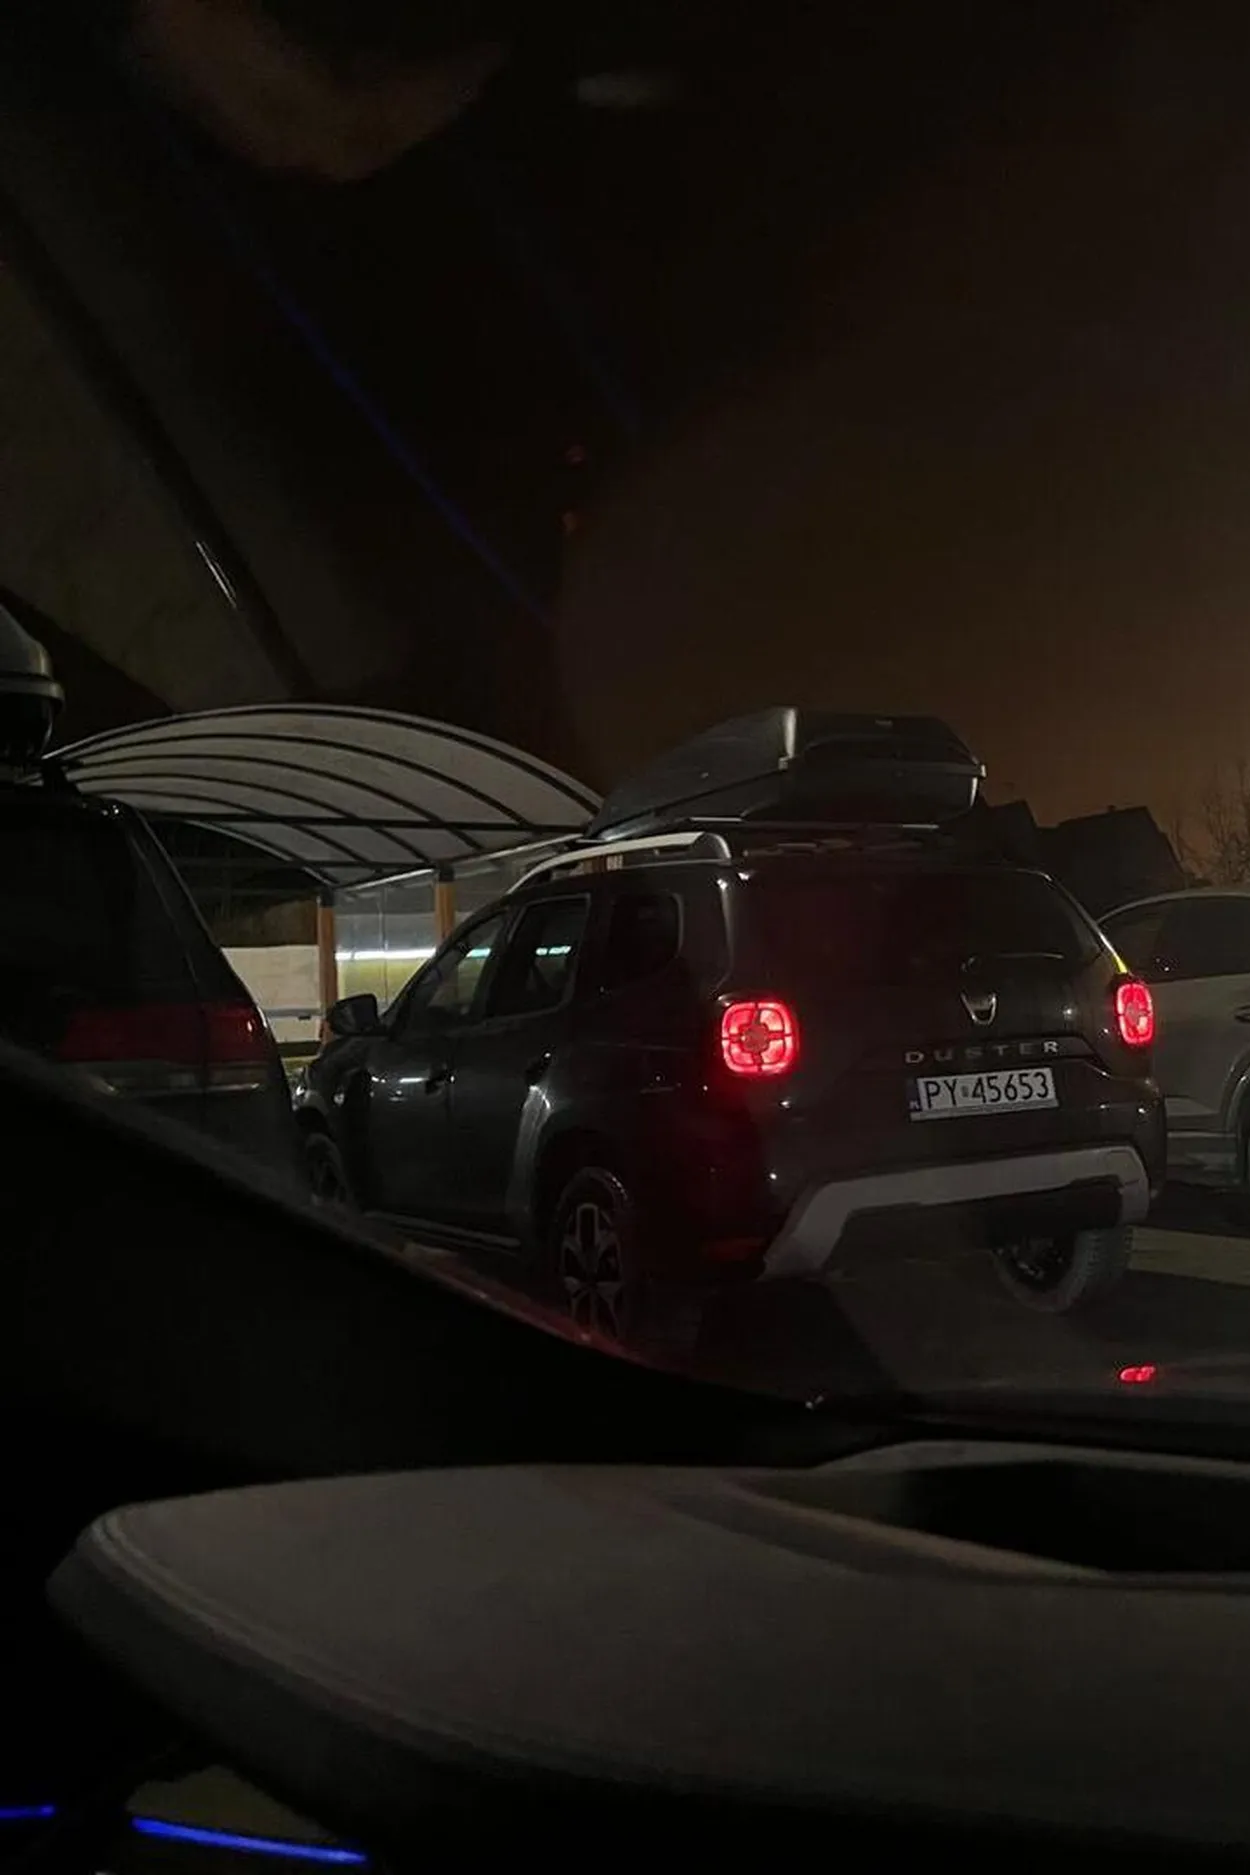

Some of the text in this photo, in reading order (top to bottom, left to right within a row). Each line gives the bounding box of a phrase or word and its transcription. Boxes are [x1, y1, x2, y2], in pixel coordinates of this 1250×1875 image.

[905, 1041, 1059, 1063] DUSTER
[924, 1072, 1049, 1109] PY 45653
